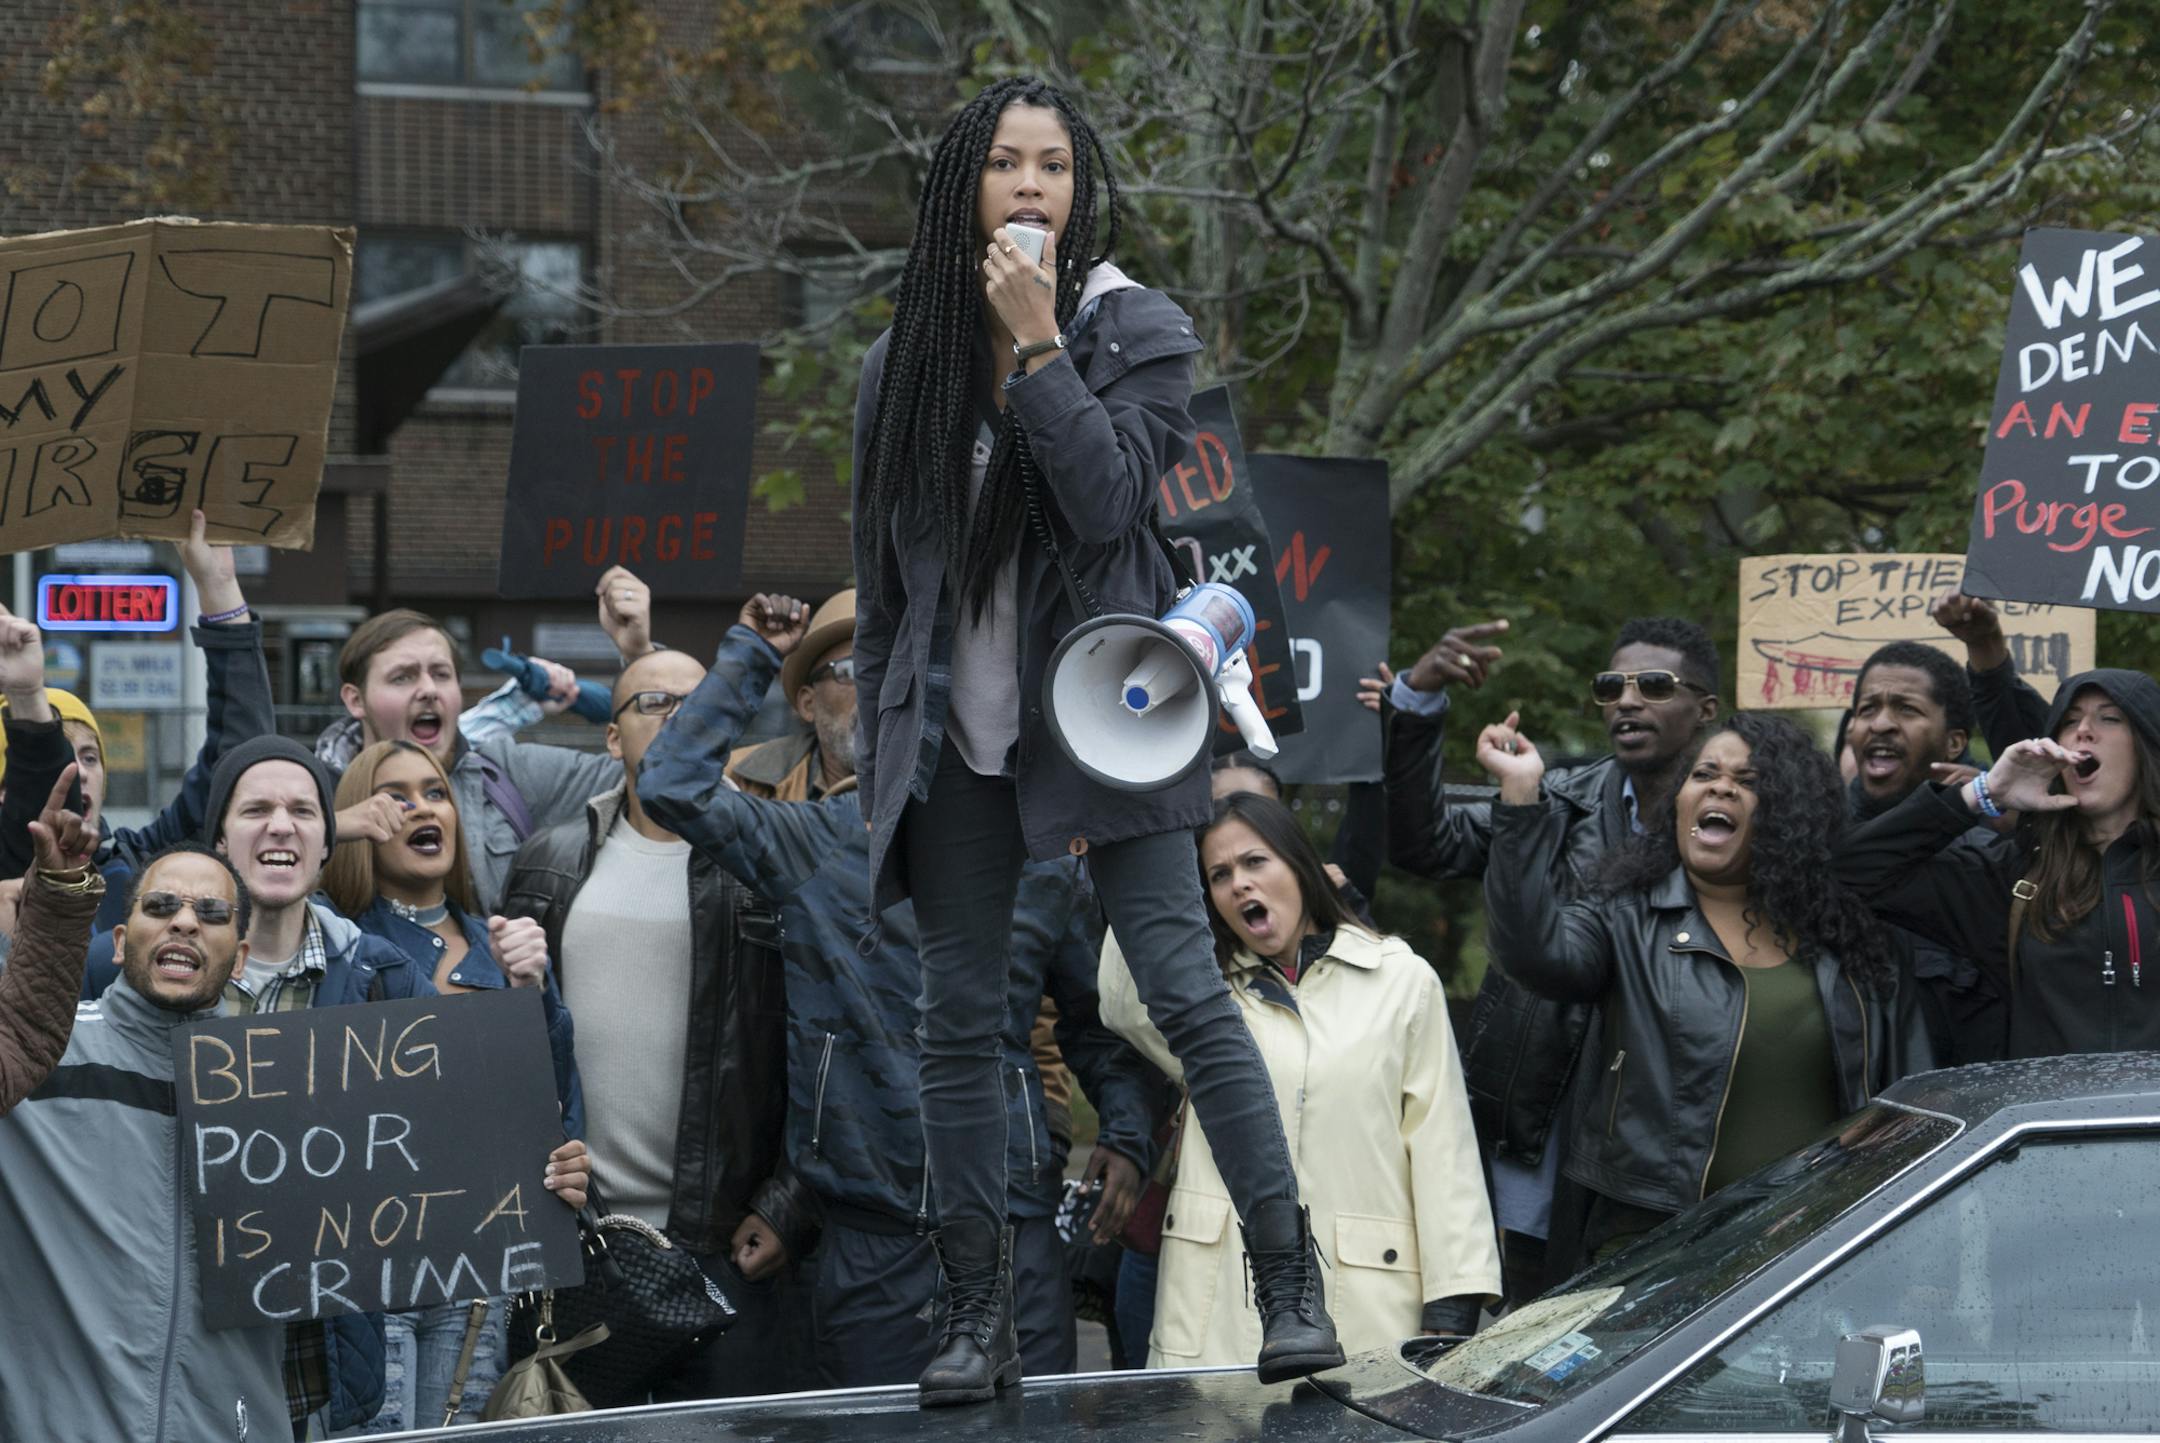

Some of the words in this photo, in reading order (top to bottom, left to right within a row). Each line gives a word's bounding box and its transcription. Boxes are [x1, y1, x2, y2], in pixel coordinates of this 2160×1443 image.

[2019, 235, 2160, 329] WE
[0, 363, 126, 432] MY
[576, 368, 715, 420] STOP
[1996, 400, 2092, 439] AN
[2118, 402, 2160, 445] E
[0, 430, 298, 536] RGE
[592, 433, 689, 484] THE
[2067, 454, 2160, 494] TO
[543, 512, 719, 567] PURGE
[1984, 479, 2156, 552] Purge
[47, 585, 167, 622] LOTTERY
[1750, 559, 1860, 601] STOP
[1870, 558, 1964, 592] THE
[189, 1014, 442, 1106] BEING
[194, 1113, 420, 1194] POOR
[217, 1210, 273, 1266] IS
[314, 1188, 467, 1257] NOT
[473, 1183, 530, 1234] A
[252, 1241, 543, 1319] CRIME
